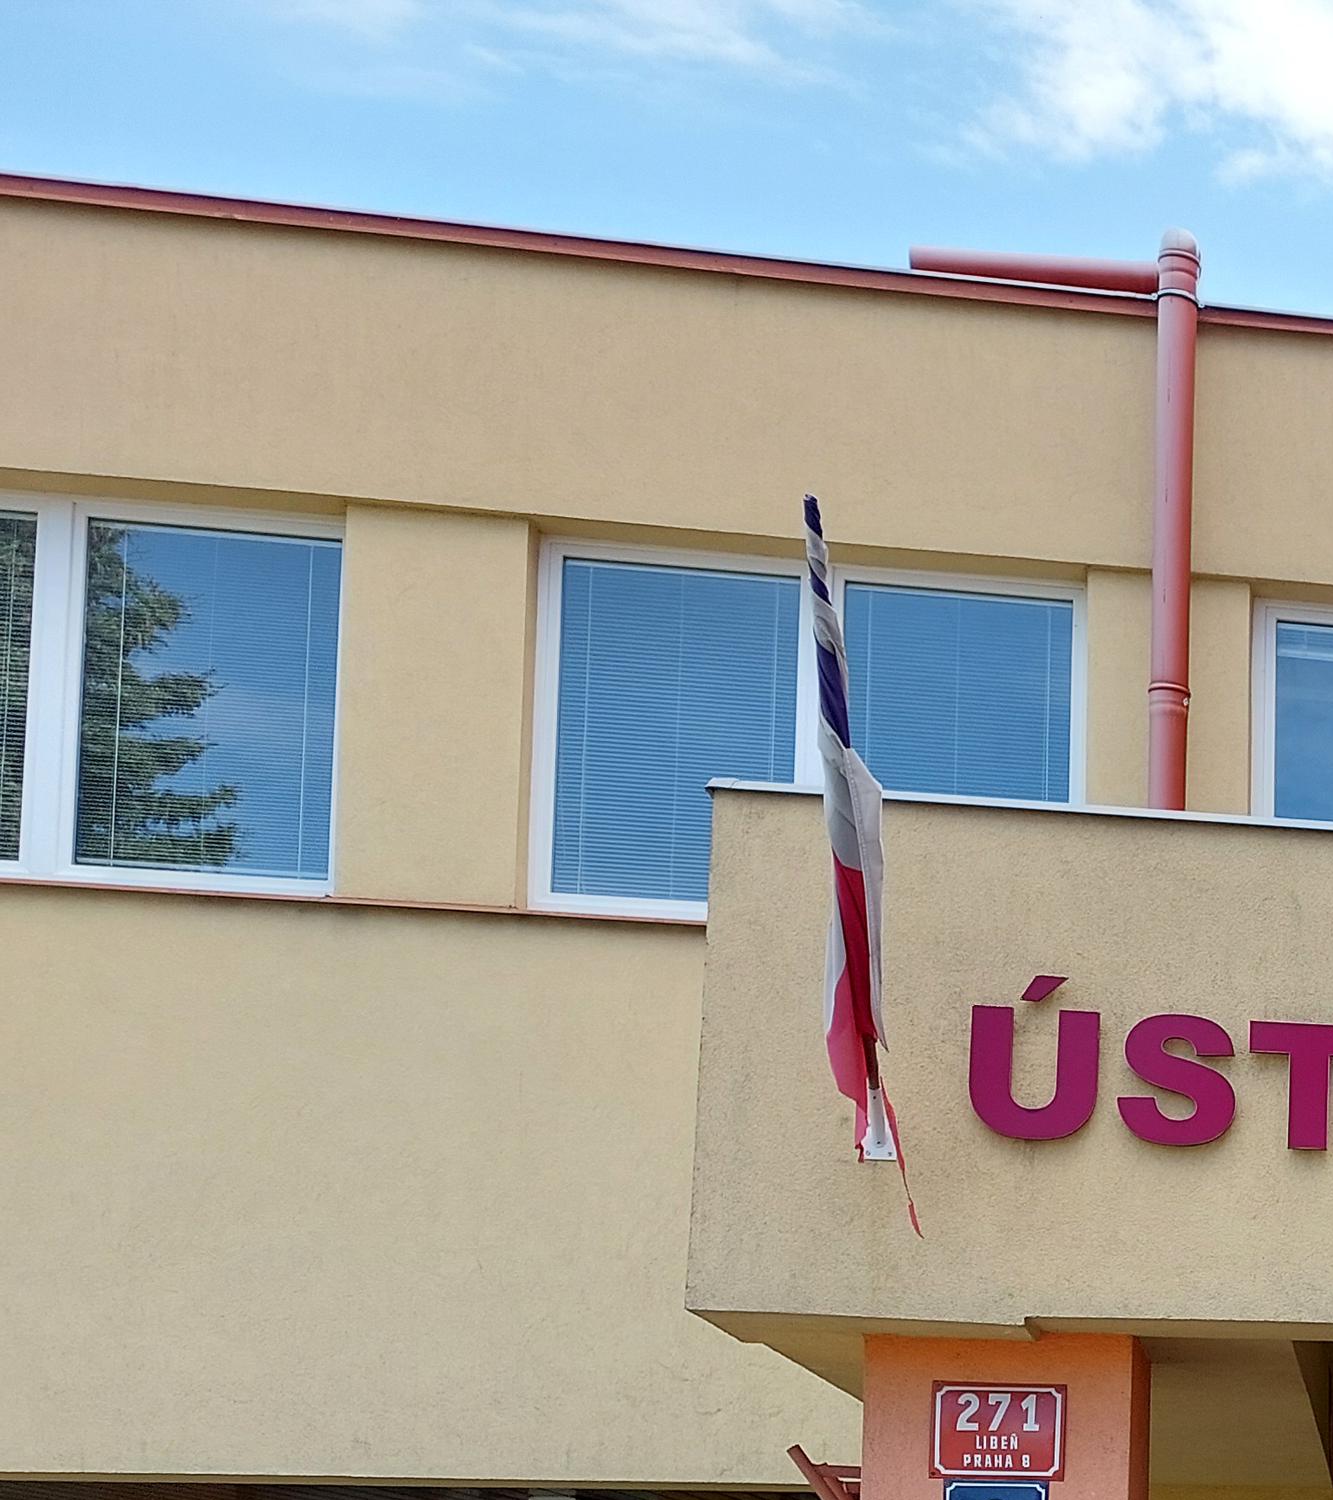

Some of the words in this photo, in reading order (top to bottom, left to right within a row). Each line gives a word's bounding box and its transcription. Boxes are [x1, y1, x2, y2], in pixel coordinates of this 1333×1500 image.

[956, 1392, 1040, 1432] 271
[976, 1433, 1019, 1450] LIBEŇ
[963, 1454, 1014, 1469] PRAHA
[1022, 1455, 1031, 1468] 8
